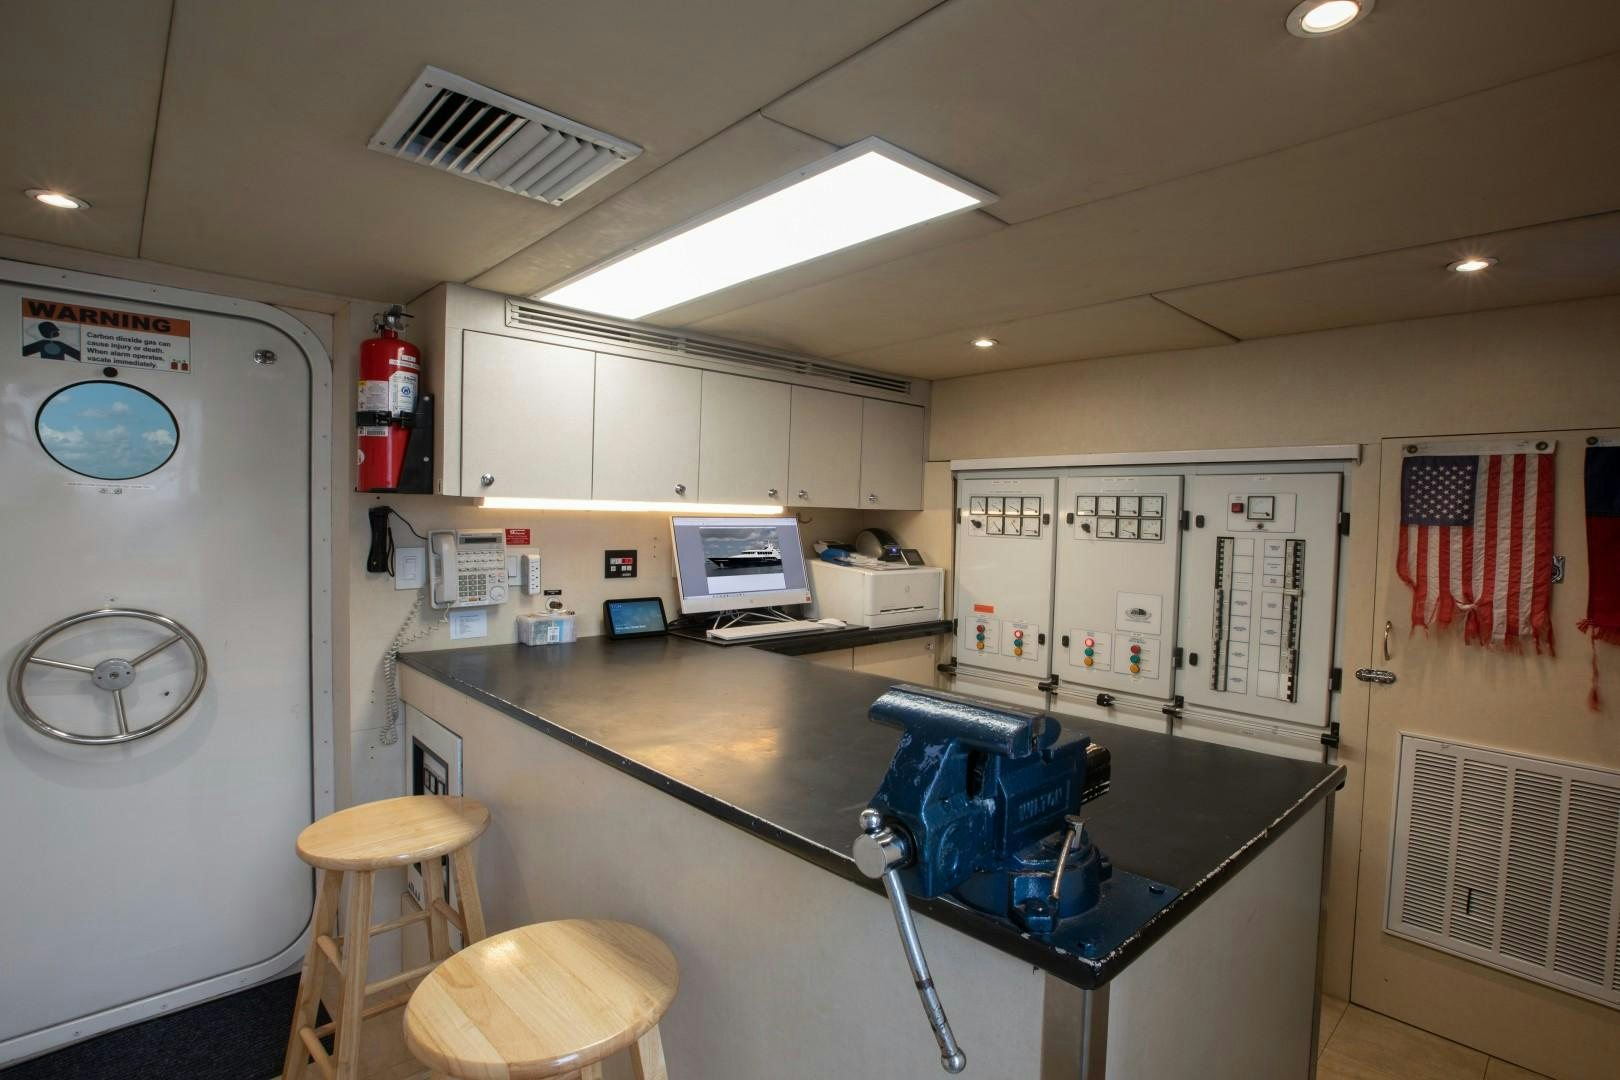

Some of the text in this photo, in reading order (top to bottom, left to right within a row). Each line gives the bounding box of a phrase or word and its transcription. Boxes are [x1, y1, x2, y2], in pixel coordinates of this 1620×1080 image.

[28, 301, 171, 333] WARNING
[87, 332, 114, 340] Carbon
[116, 335, 142, 344] dioxide
[111, 342, 131, 351] injury
[87, 347, 108, 355] When
[110, 349, 131, 358] alarm
